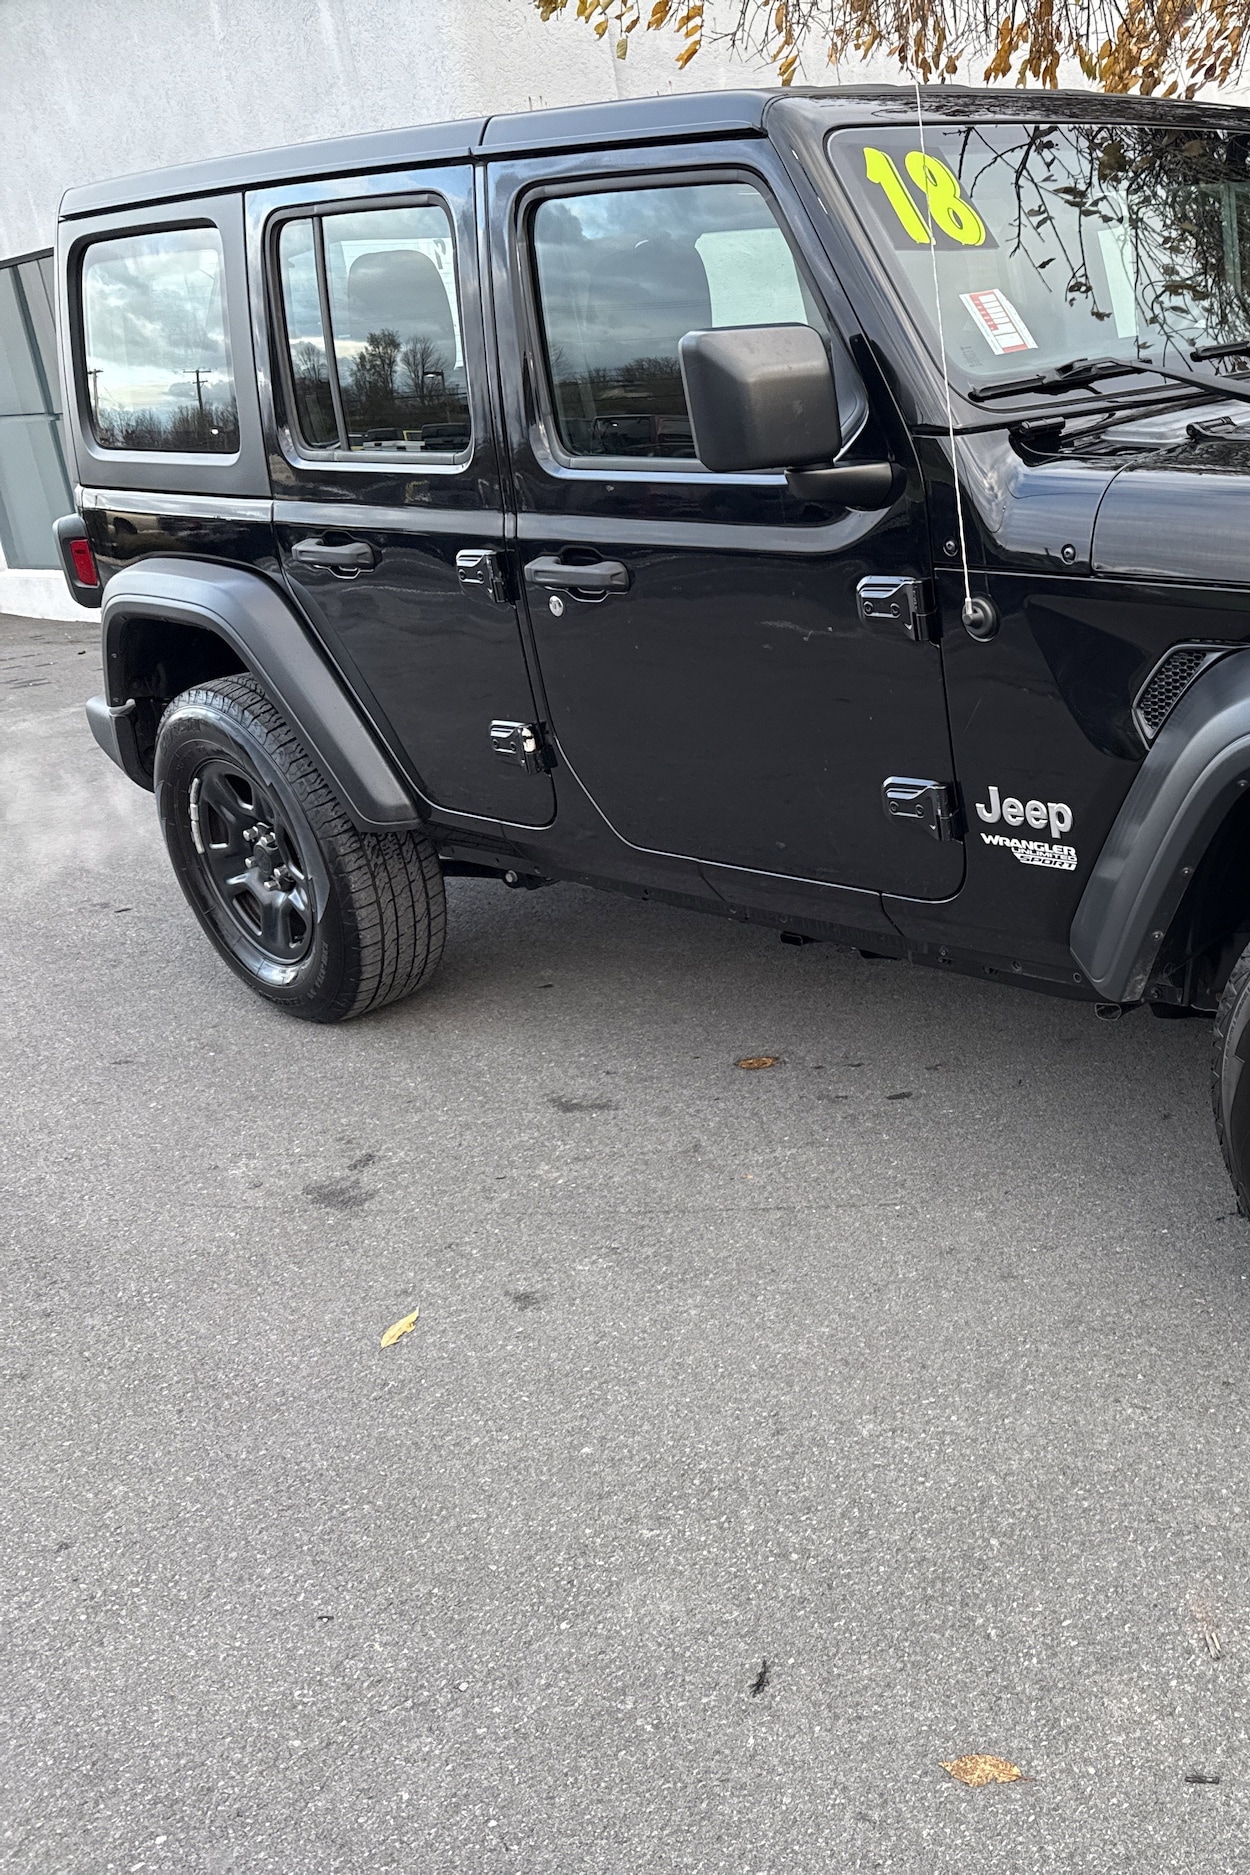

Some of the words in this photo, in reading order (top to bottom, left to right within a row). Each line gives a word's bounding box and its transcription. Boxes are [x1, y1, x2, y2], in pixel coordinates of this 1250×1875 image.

[863, 147, 987, 246] 18
[975, 786, 1074, 839] Jeep
[980, 832, 1077, 857] WRANGLER
[1011, 846, 1078, 862] UNLIMITED
[1018, 854, 1077, 870] SPORT
